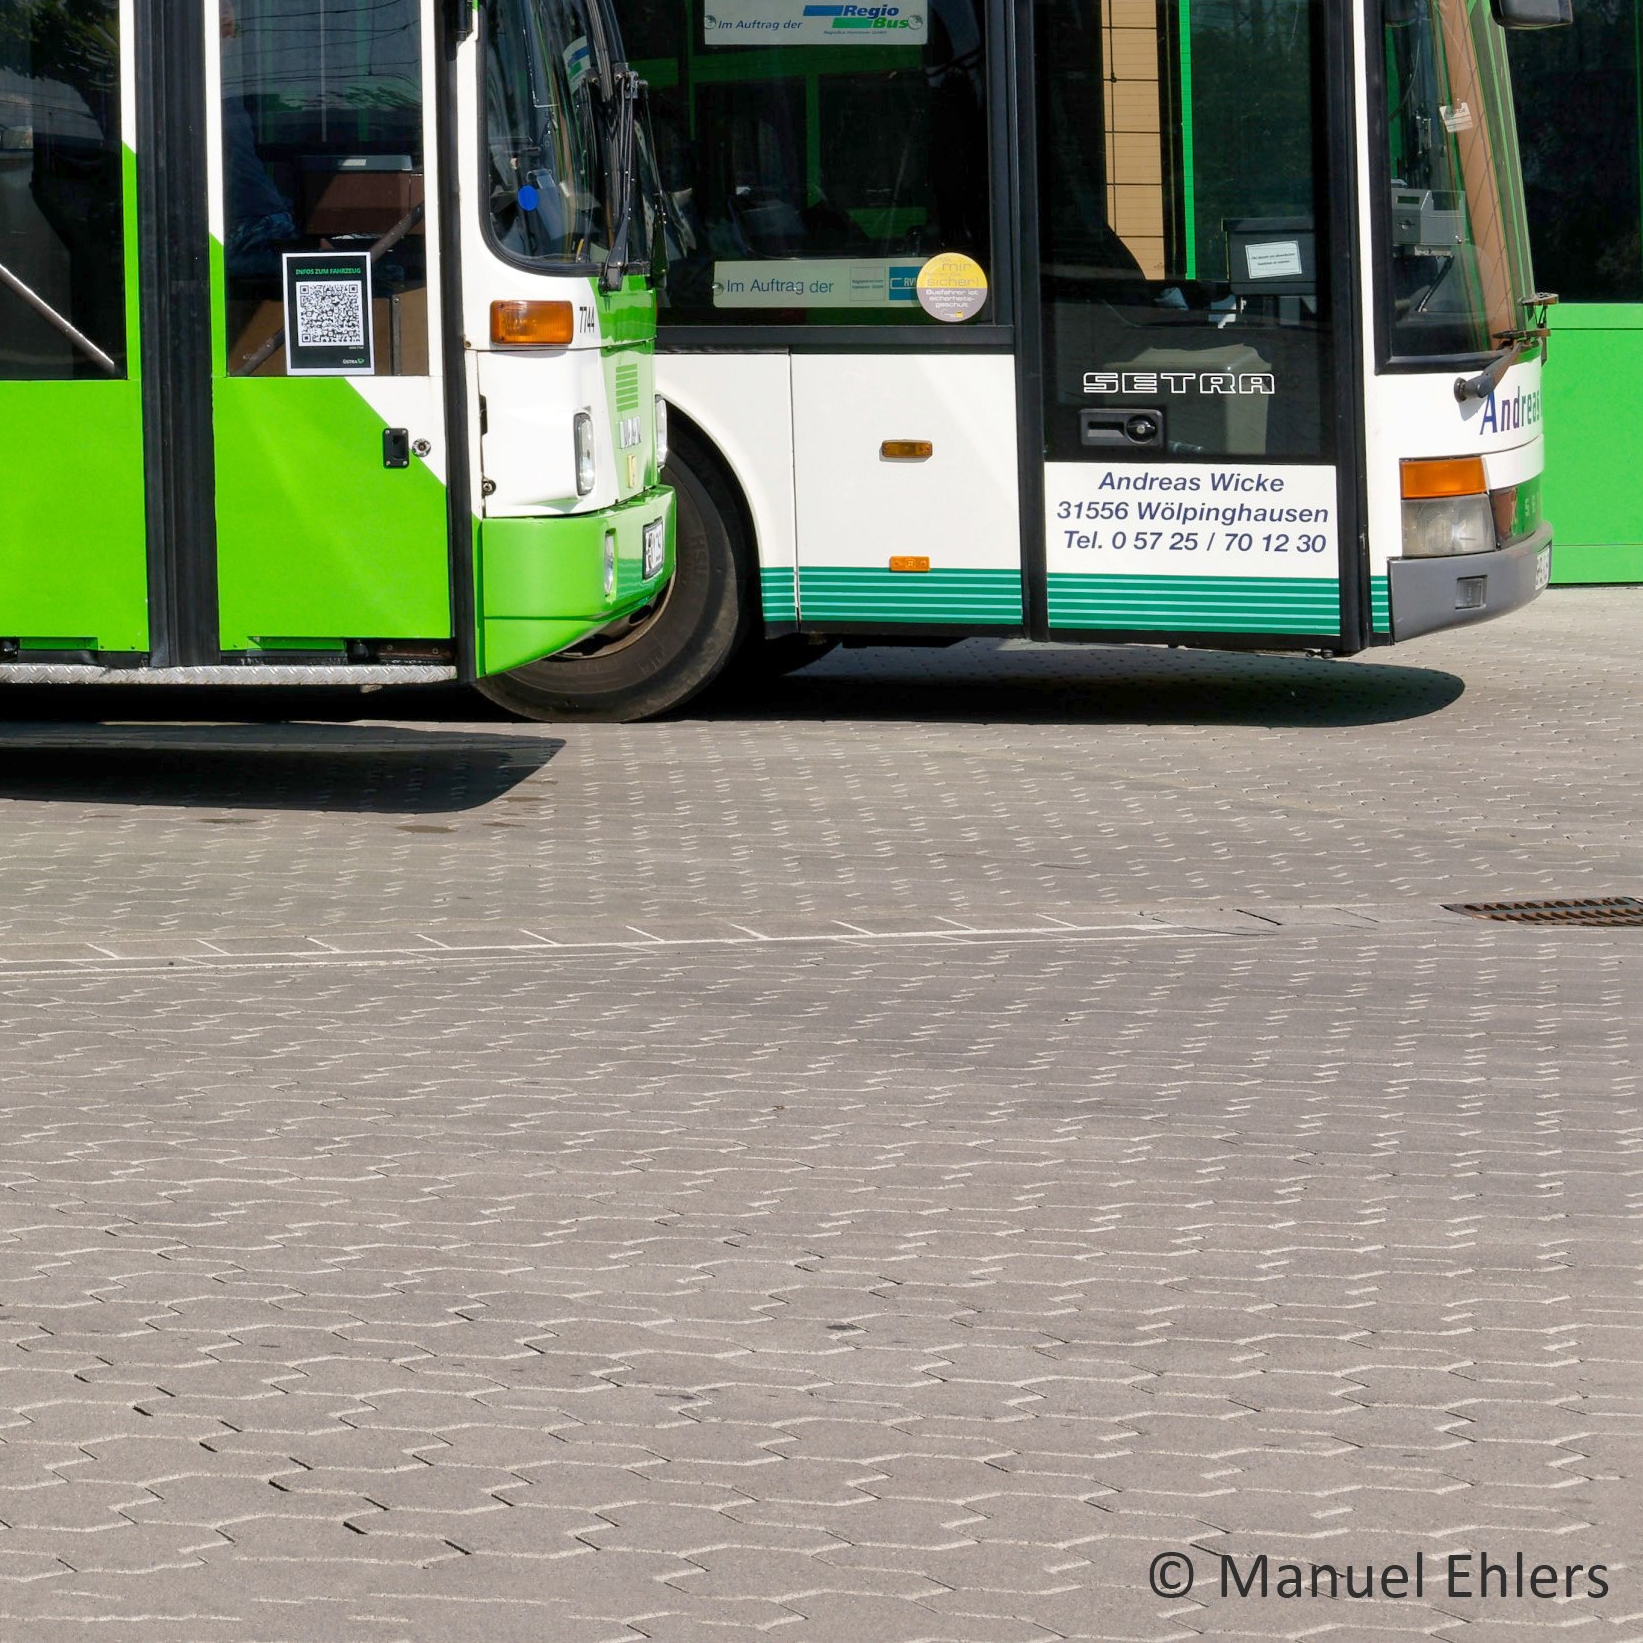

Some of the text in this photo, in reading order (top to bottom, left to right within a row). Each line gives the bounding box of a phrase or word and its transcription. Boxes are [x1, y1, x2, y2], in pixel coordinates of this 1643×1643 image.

[842, 4, 900, 19] Regio
[718, 20, 803, 31] Im Auftrag der
[872, 17, 908, 29] Bus
[727, 279, 834, 295] Im Auftrag der
[579, 306, 595, 334] 7744
[1083, 372, 1275, 394] SETRA
[1479, 385, 1540, 435] Andreas
[1098, 472, 1285, 492] Andreas Wicke
[1057, 501, 1329, 526] 31556 Wölpinghausen
[1064, 530, 1103, 549] Tel.
[1112, 532, 1126, 550] 0
[1133, 531, 1162, 550] 57
[1169, 532, 1199, 550] 25
[1224, 532, 1253, 551] 70
[1263, 533, 1288, 552] 12
[1296, 534, 1327, 553] 30
